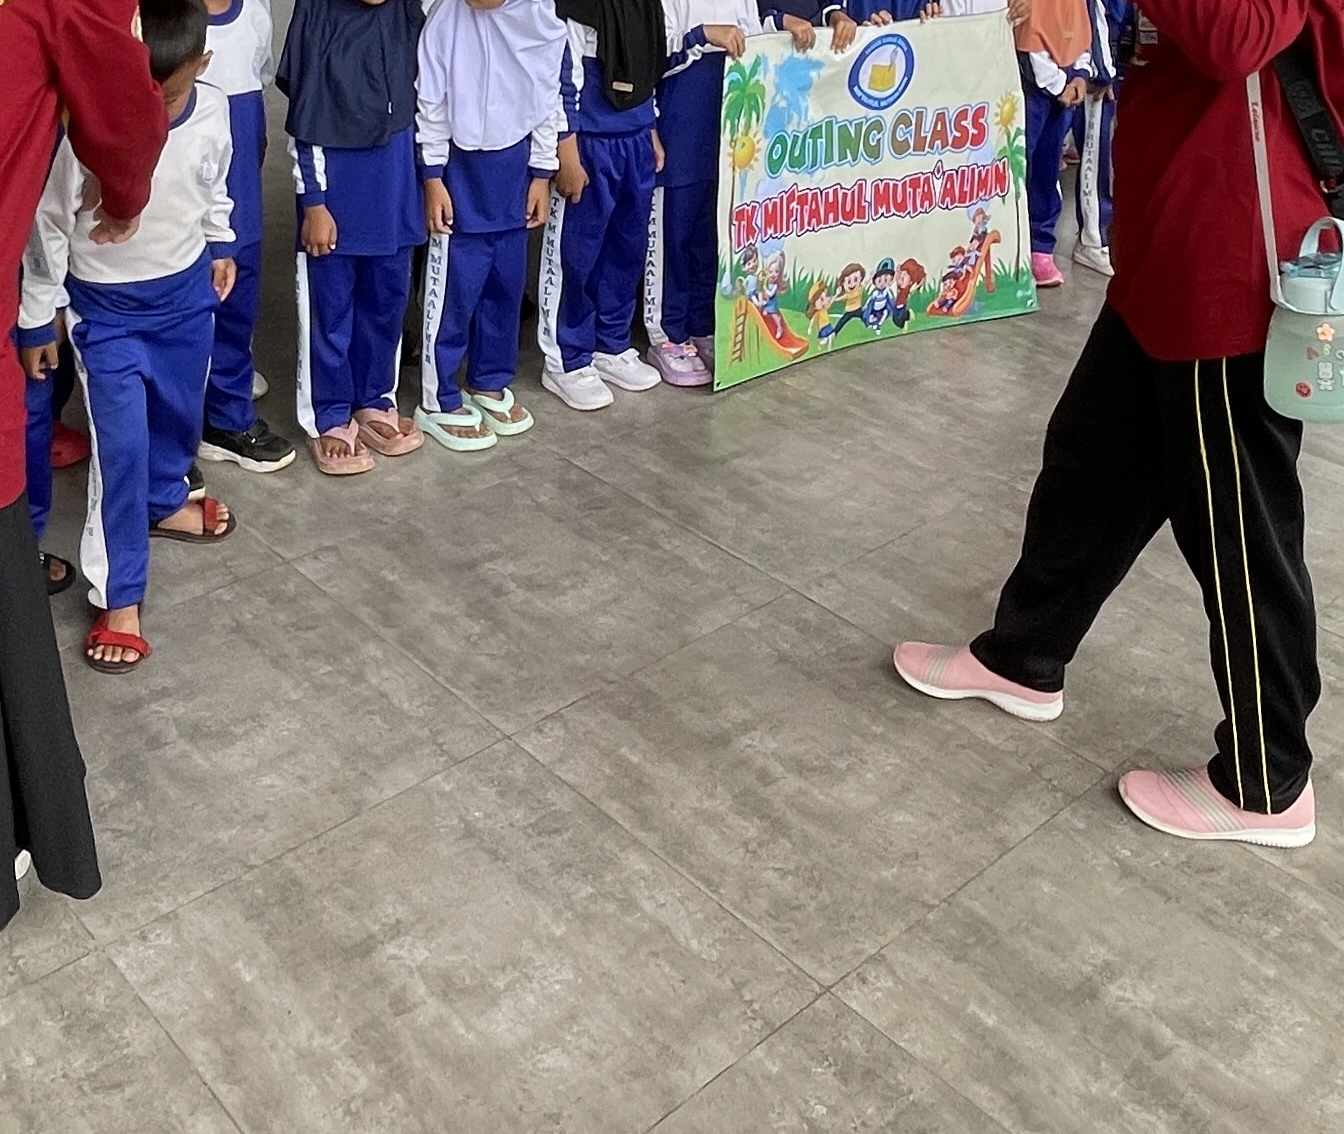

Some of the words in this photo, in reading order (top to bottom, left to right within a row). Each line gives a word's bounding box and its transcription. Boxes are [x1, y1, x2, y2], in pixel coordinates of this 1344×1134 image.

[766, 116, 884, 178] OUTING
[890, 103, 989, 158] CLASS
[733, 201, 758, 252] TK
[760, 180, 868, 242] MIFTAHUL
